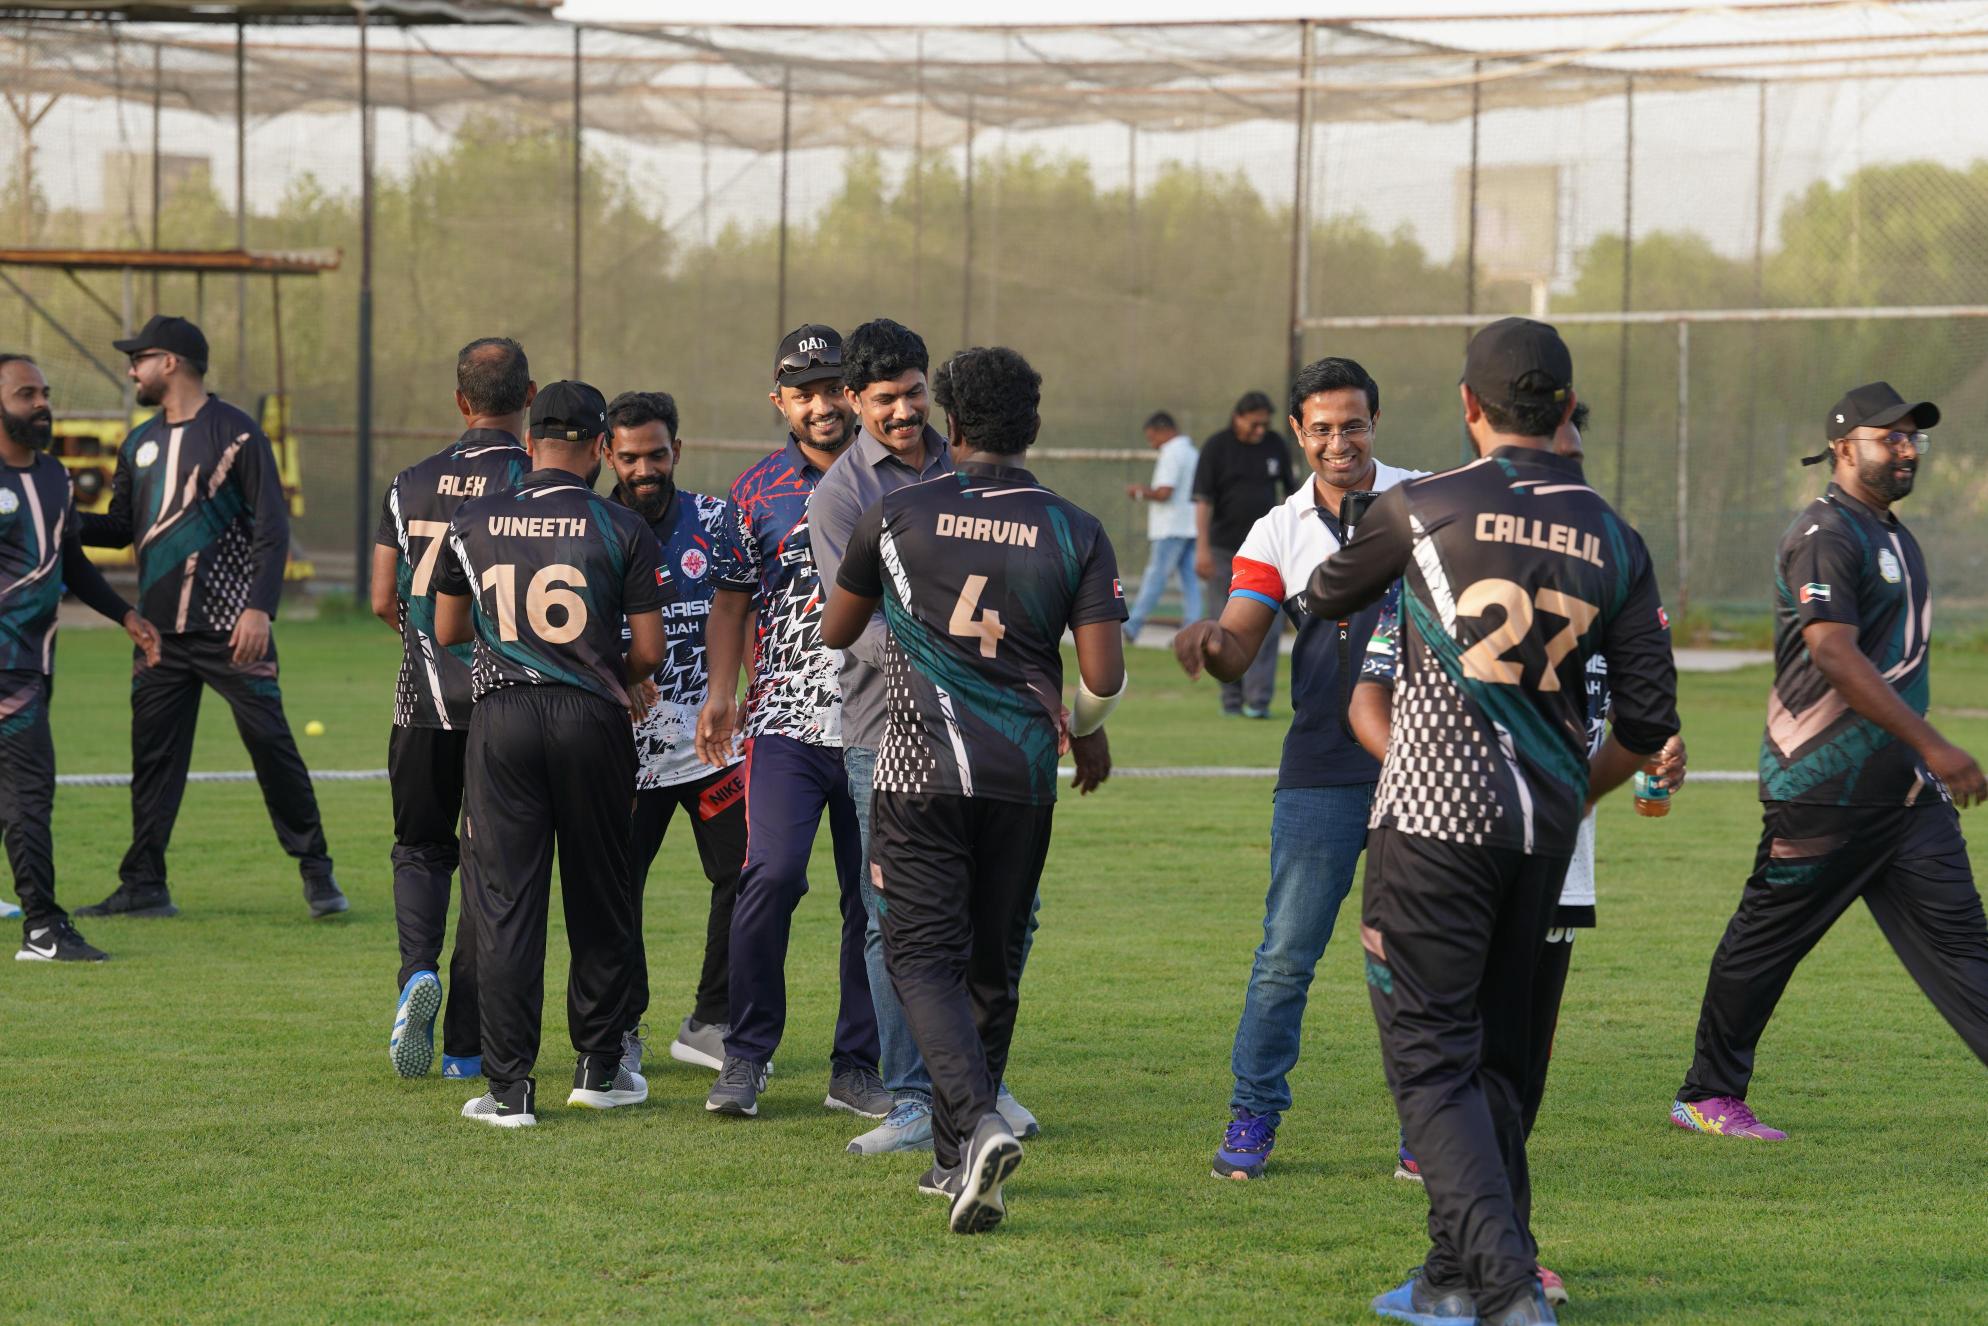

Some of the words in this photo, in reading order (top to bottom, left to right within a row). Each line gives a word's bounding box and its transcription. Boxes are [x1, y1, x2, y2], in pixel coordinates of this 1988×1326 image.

[798, 336, 828, 353] DAD
[437, 475, 487, 497] ALEX
[488, 516, 587, 538] VINEETH
[935, 513, 1039, 548] DARVIN
[1474, 512, 1605, 567] CALLELIL
[481, 563, 588, 644] 16
[661, 599, 712, 618] ARISH
[949, 574, 1006, 658] 4
[1456, 578, 1600, 694] 27
[708, 775, 745, 806] NIKE
